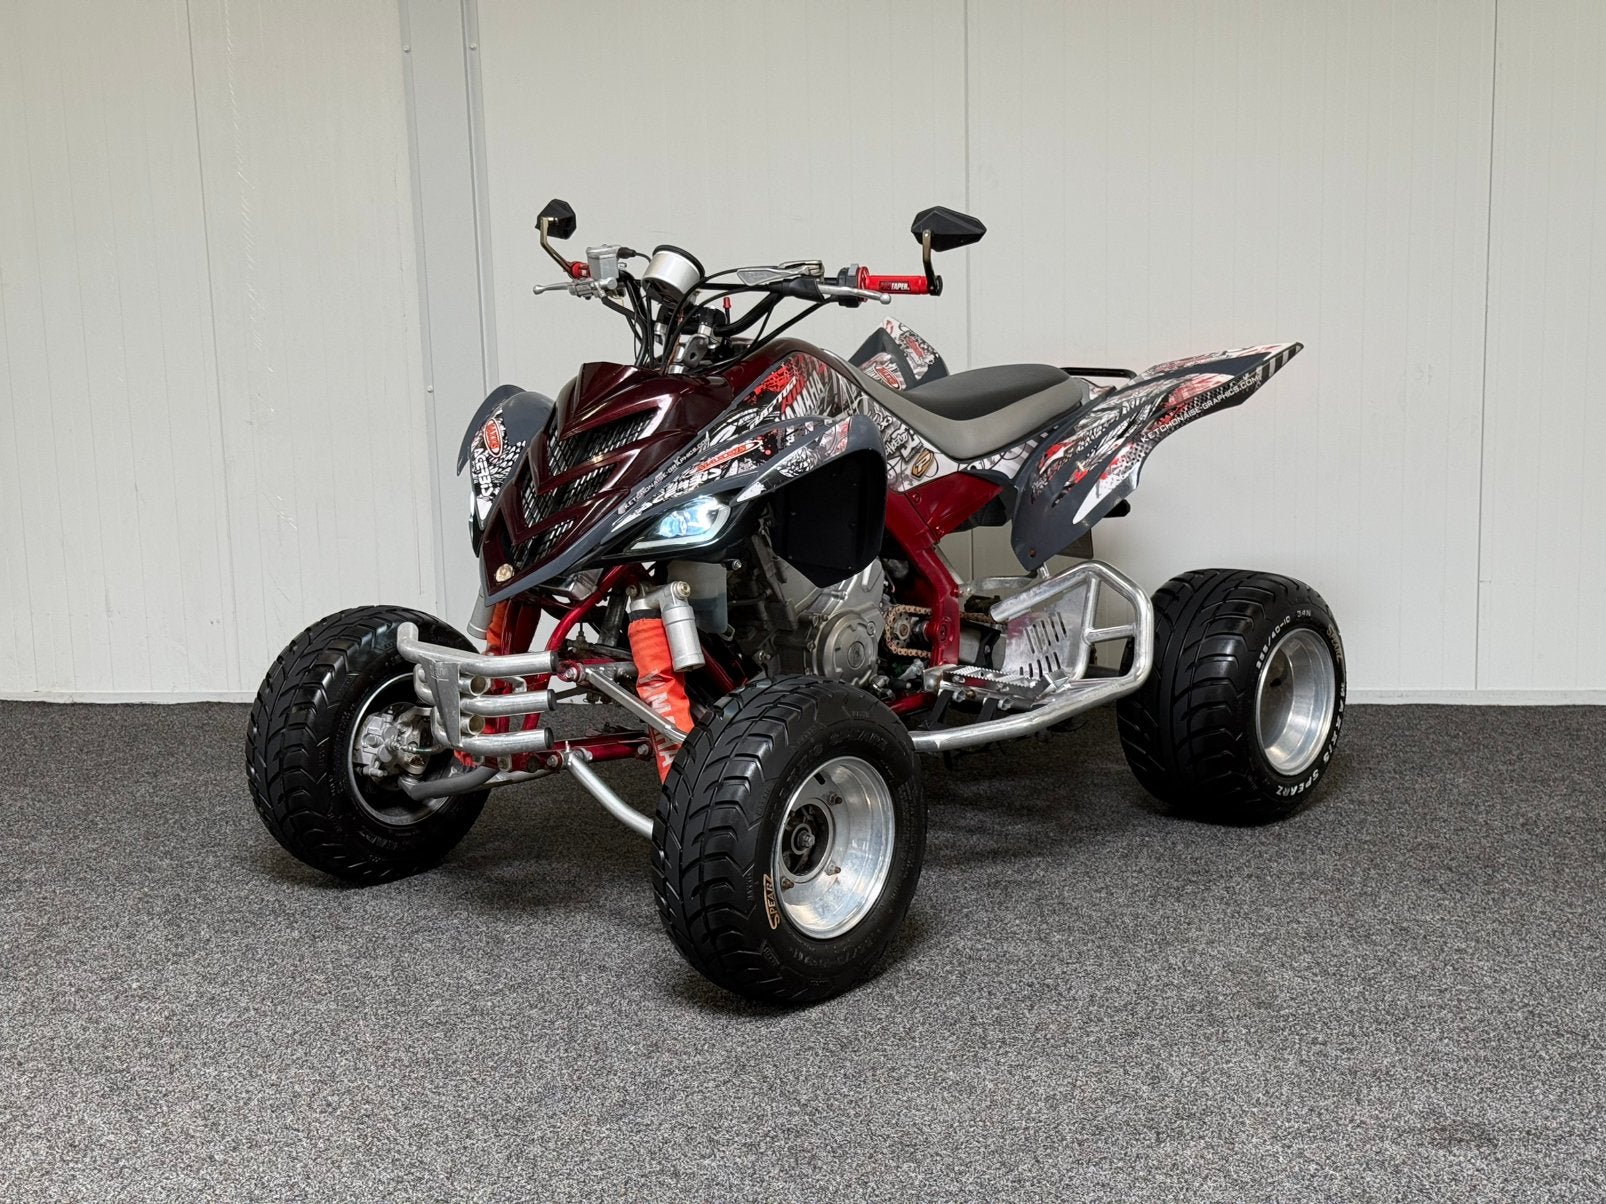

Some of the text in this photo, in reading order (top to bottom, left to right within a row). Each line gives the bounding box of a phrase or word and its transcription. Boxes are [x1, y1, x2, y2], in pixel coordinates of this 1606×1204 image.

[781, 369, 826, 420] AMAHA
[637, 668, 681, 768] YAMHA
[1276, 768, 1319, 797] SPEARZ
[763, 873, 781, 930] SPEARZ
